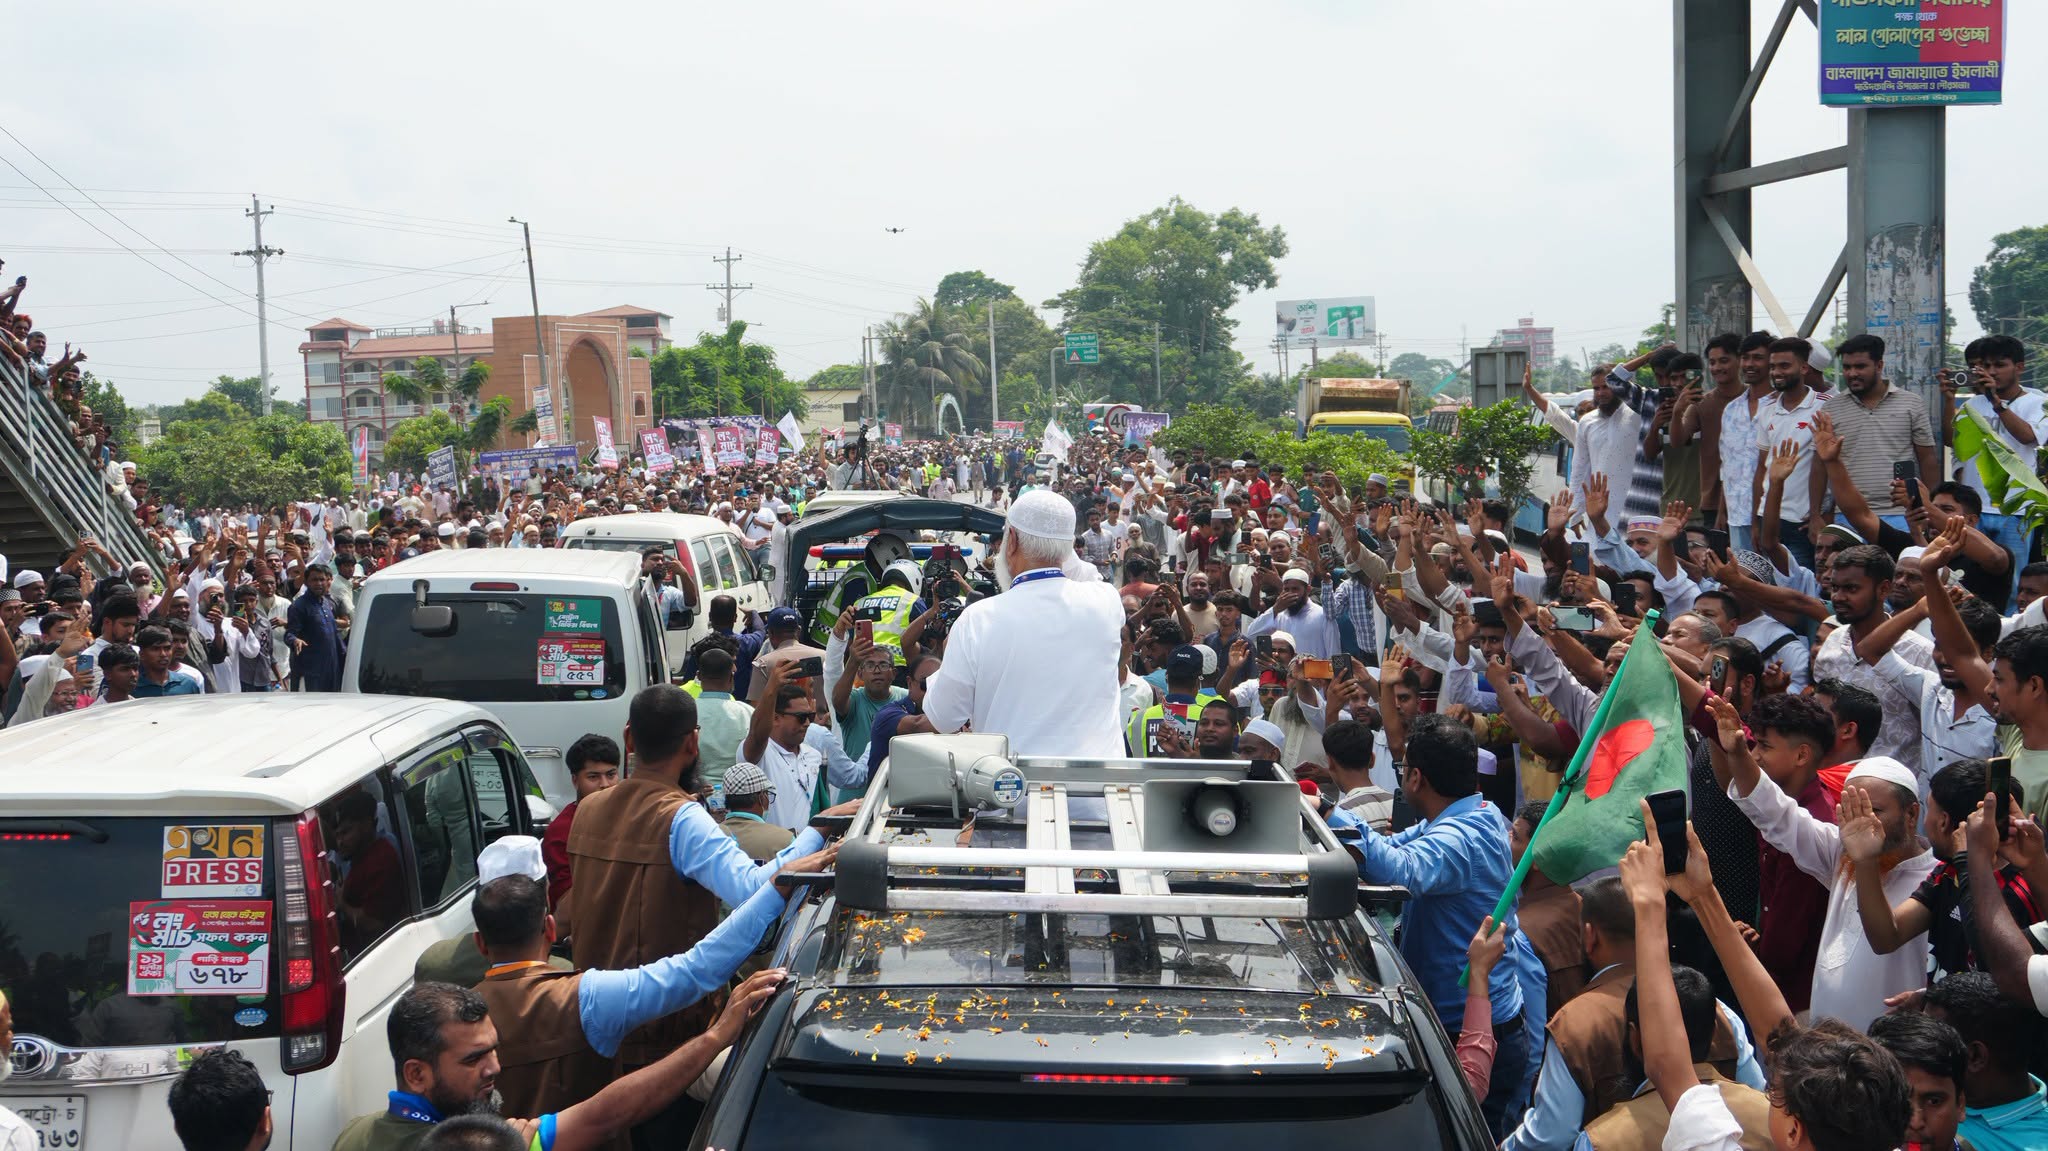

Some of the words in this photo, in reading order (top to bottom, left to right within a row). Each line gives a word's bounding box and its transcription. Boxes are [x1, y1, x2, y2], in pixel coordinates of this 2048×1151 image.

[1915, 12, 1938, 22] থেকে
[1836, 28, 1868, 45] লাল
[1871, 27, 1936, 48] গোলাপের
[1938, 26, 1990, 48] শুভেচ্ছা
[1825, 66, 1884, 81] বাংলাদেশ
[1887, 65, 1948, 80] জামায়াতে
[1951, 61, 1999, 79] ইসলামী
[863, 597, 900, 610] POLICE
[567, 672, 595, 680] ৫৫৭
[164, 825, 264, 860] এখন
[166, 862, 260, 884] PRESS
[152, 912, 185, 930] লং
[151, 922, 197, 947] মার্চ
[196, 932, 230, 943] সফল
[233, 932, 268, 944] করুন
[140, 954, 162, 964] ১১
[189, 968, 249, 984] ৬৭৮
[36, 1129, 79, 1148] ৭৬৩
